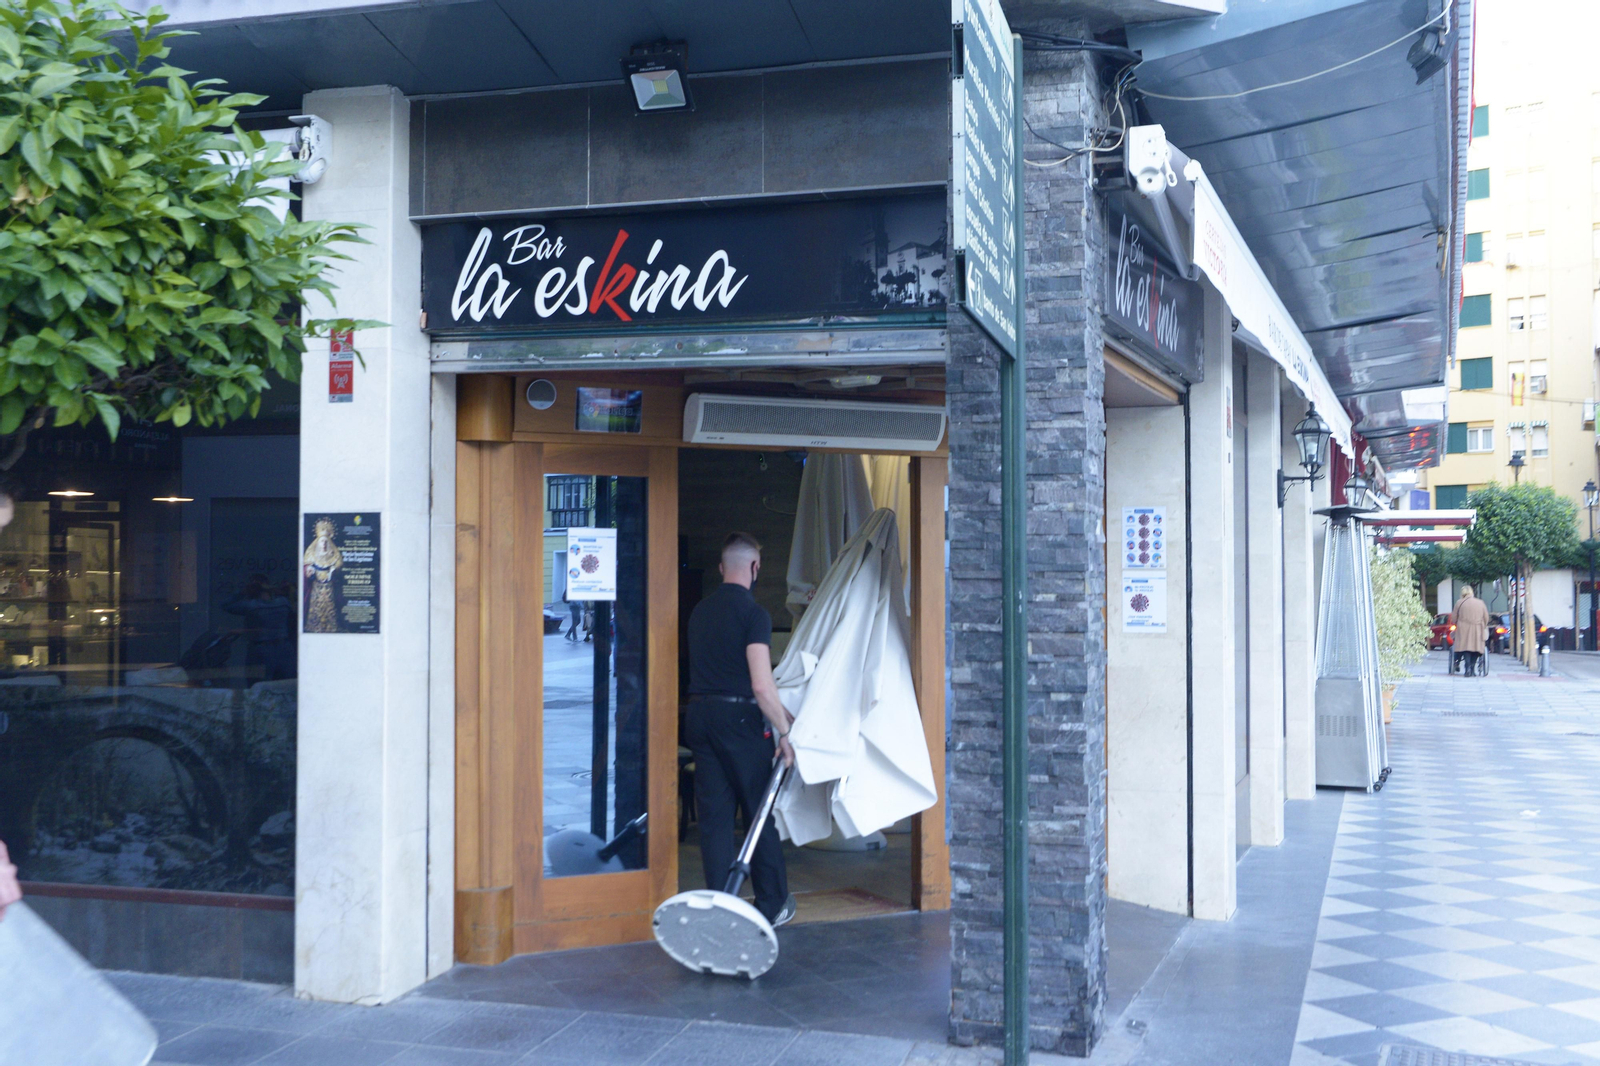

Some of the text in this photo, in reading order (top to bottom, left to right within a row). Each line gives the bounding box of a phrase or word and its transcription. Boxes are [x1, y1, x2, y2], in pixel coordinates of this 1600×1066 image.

[503, 224, 567, 265] Bar
[982, 225, 988, 245] de
[1129, 224, 1144, 267] Bar
[451, 227, 749, 322] la eskina
[1116, 213, 1180, 352] la eskina
